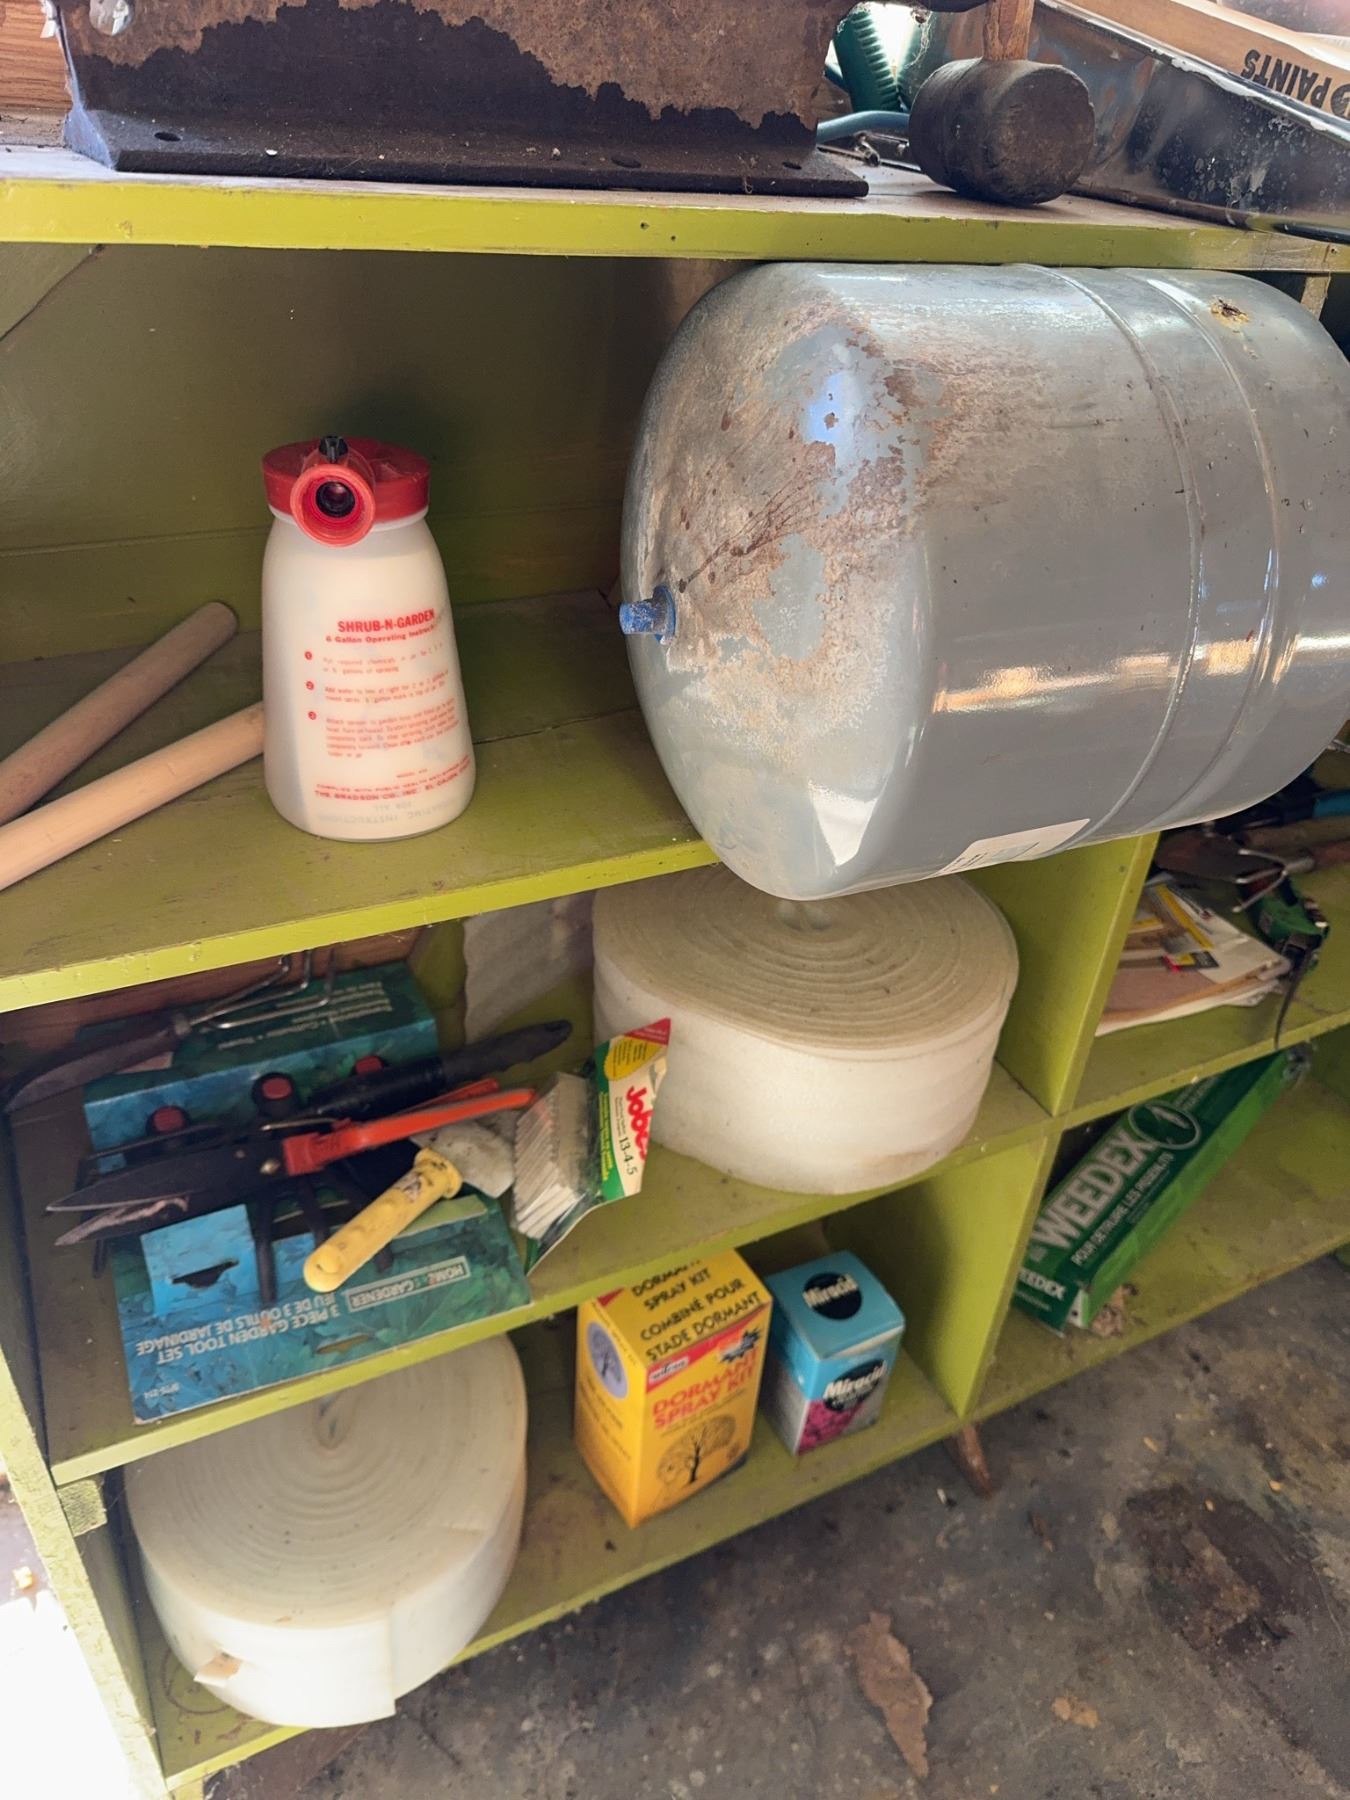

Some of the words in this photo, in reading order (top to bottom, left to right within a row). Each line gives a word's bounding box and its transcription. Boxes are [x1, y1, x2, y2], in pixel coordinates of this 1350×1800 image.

[1240, 48, 1332, 109] PAINTS
[337, 608, 435, 633] SHRUB-N-GARDEN
[334, 635, 362, 643] Gallon
[365, 633, 406, 644] Operating
[1034, 1128, 1160, 1250] WEEDEX
[429, 1263, 465, 1286] HOME
[351, 1279, 419, 1309] GARDENER
[644, 1282, 686, 1311] SPRAY
[688, 1268, 711, 1287] KIT
[705, 1278, 745, 1306] POUR
[282, 1303, 292, 1313] 3
[294, 1297, 312, 1311] DE
[328, 1303, 341, 1317] 3
[216, 1319, 232, 1335] DE
[234, 1306, 281, 1329] OUTILS
[292, 1307, 328, 1329] PIECE
[646, 1328, 691, 1361] STADE
[692, 1291, 762, 1336] DORMANT
[136, 1324, 211, 1356] JARDINAGE
[229, 1318, 289, 1346] GARDEN
[158, 1346, 184, 1365] SET
[189, 1335, 226, 1356] TOOL
[653, 1350, 757, 1417] DORMANT
[654, 1383, 728, 1430] SPRAY
